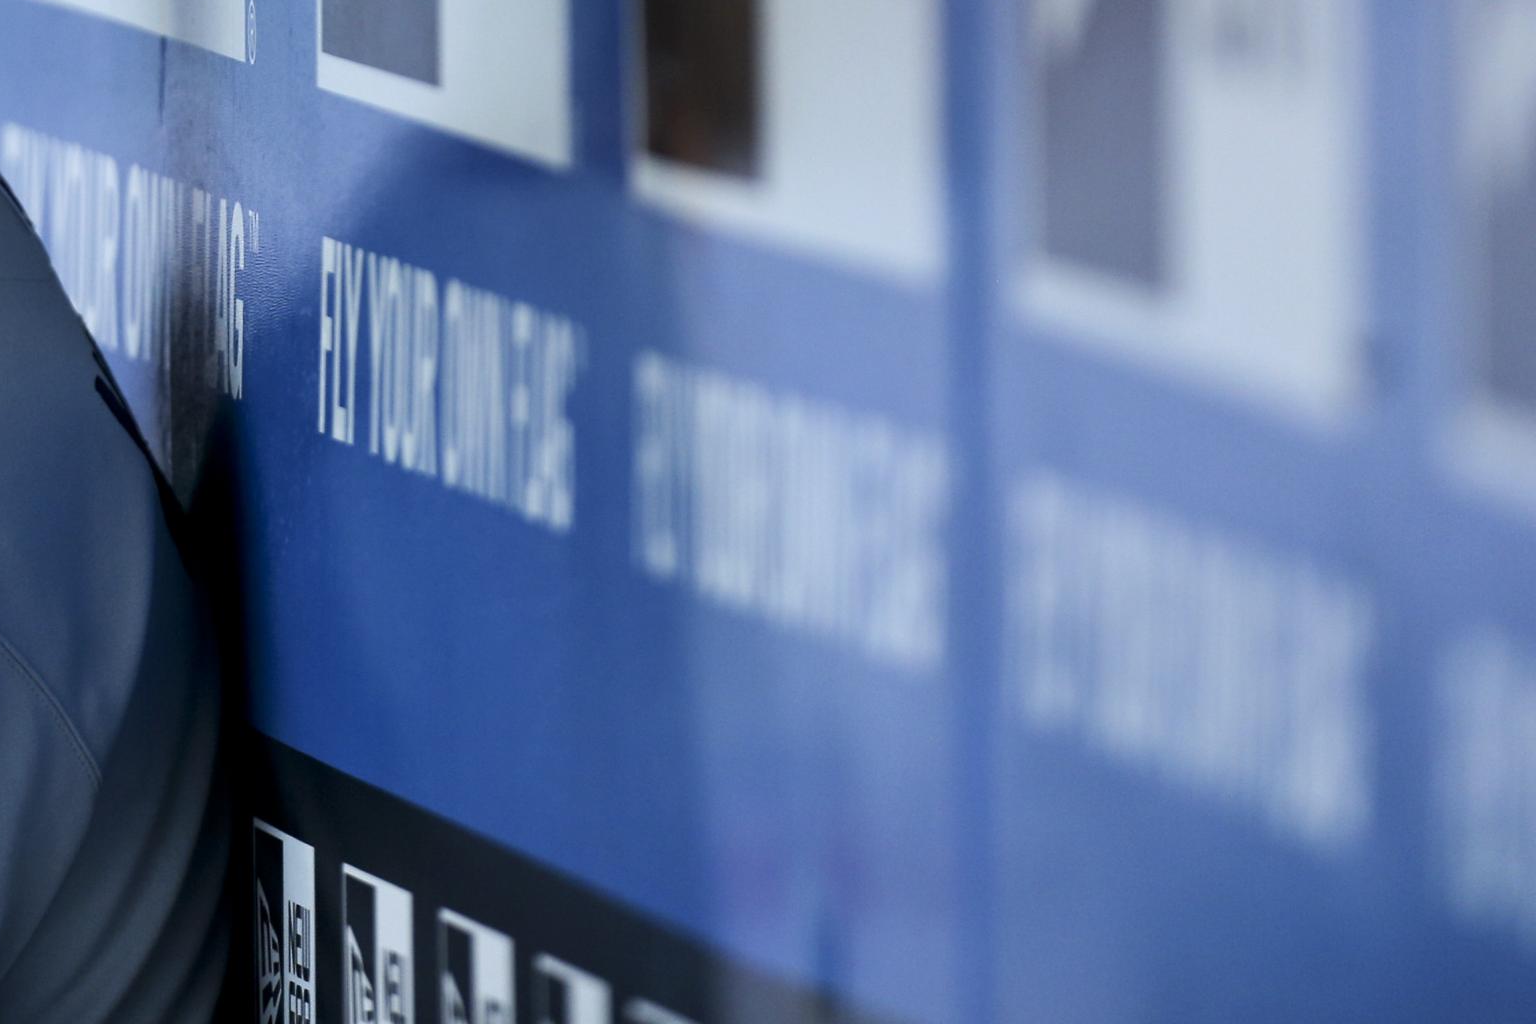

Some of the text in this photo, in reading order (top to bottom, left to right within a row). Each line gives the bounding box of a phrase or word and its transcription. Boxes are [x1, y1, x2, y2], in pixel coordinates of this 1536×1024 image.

[318, 235, 364, 446] FLY
[367, 250, 440, 478] YOUR
[287, 899, 311, 983] NEW
